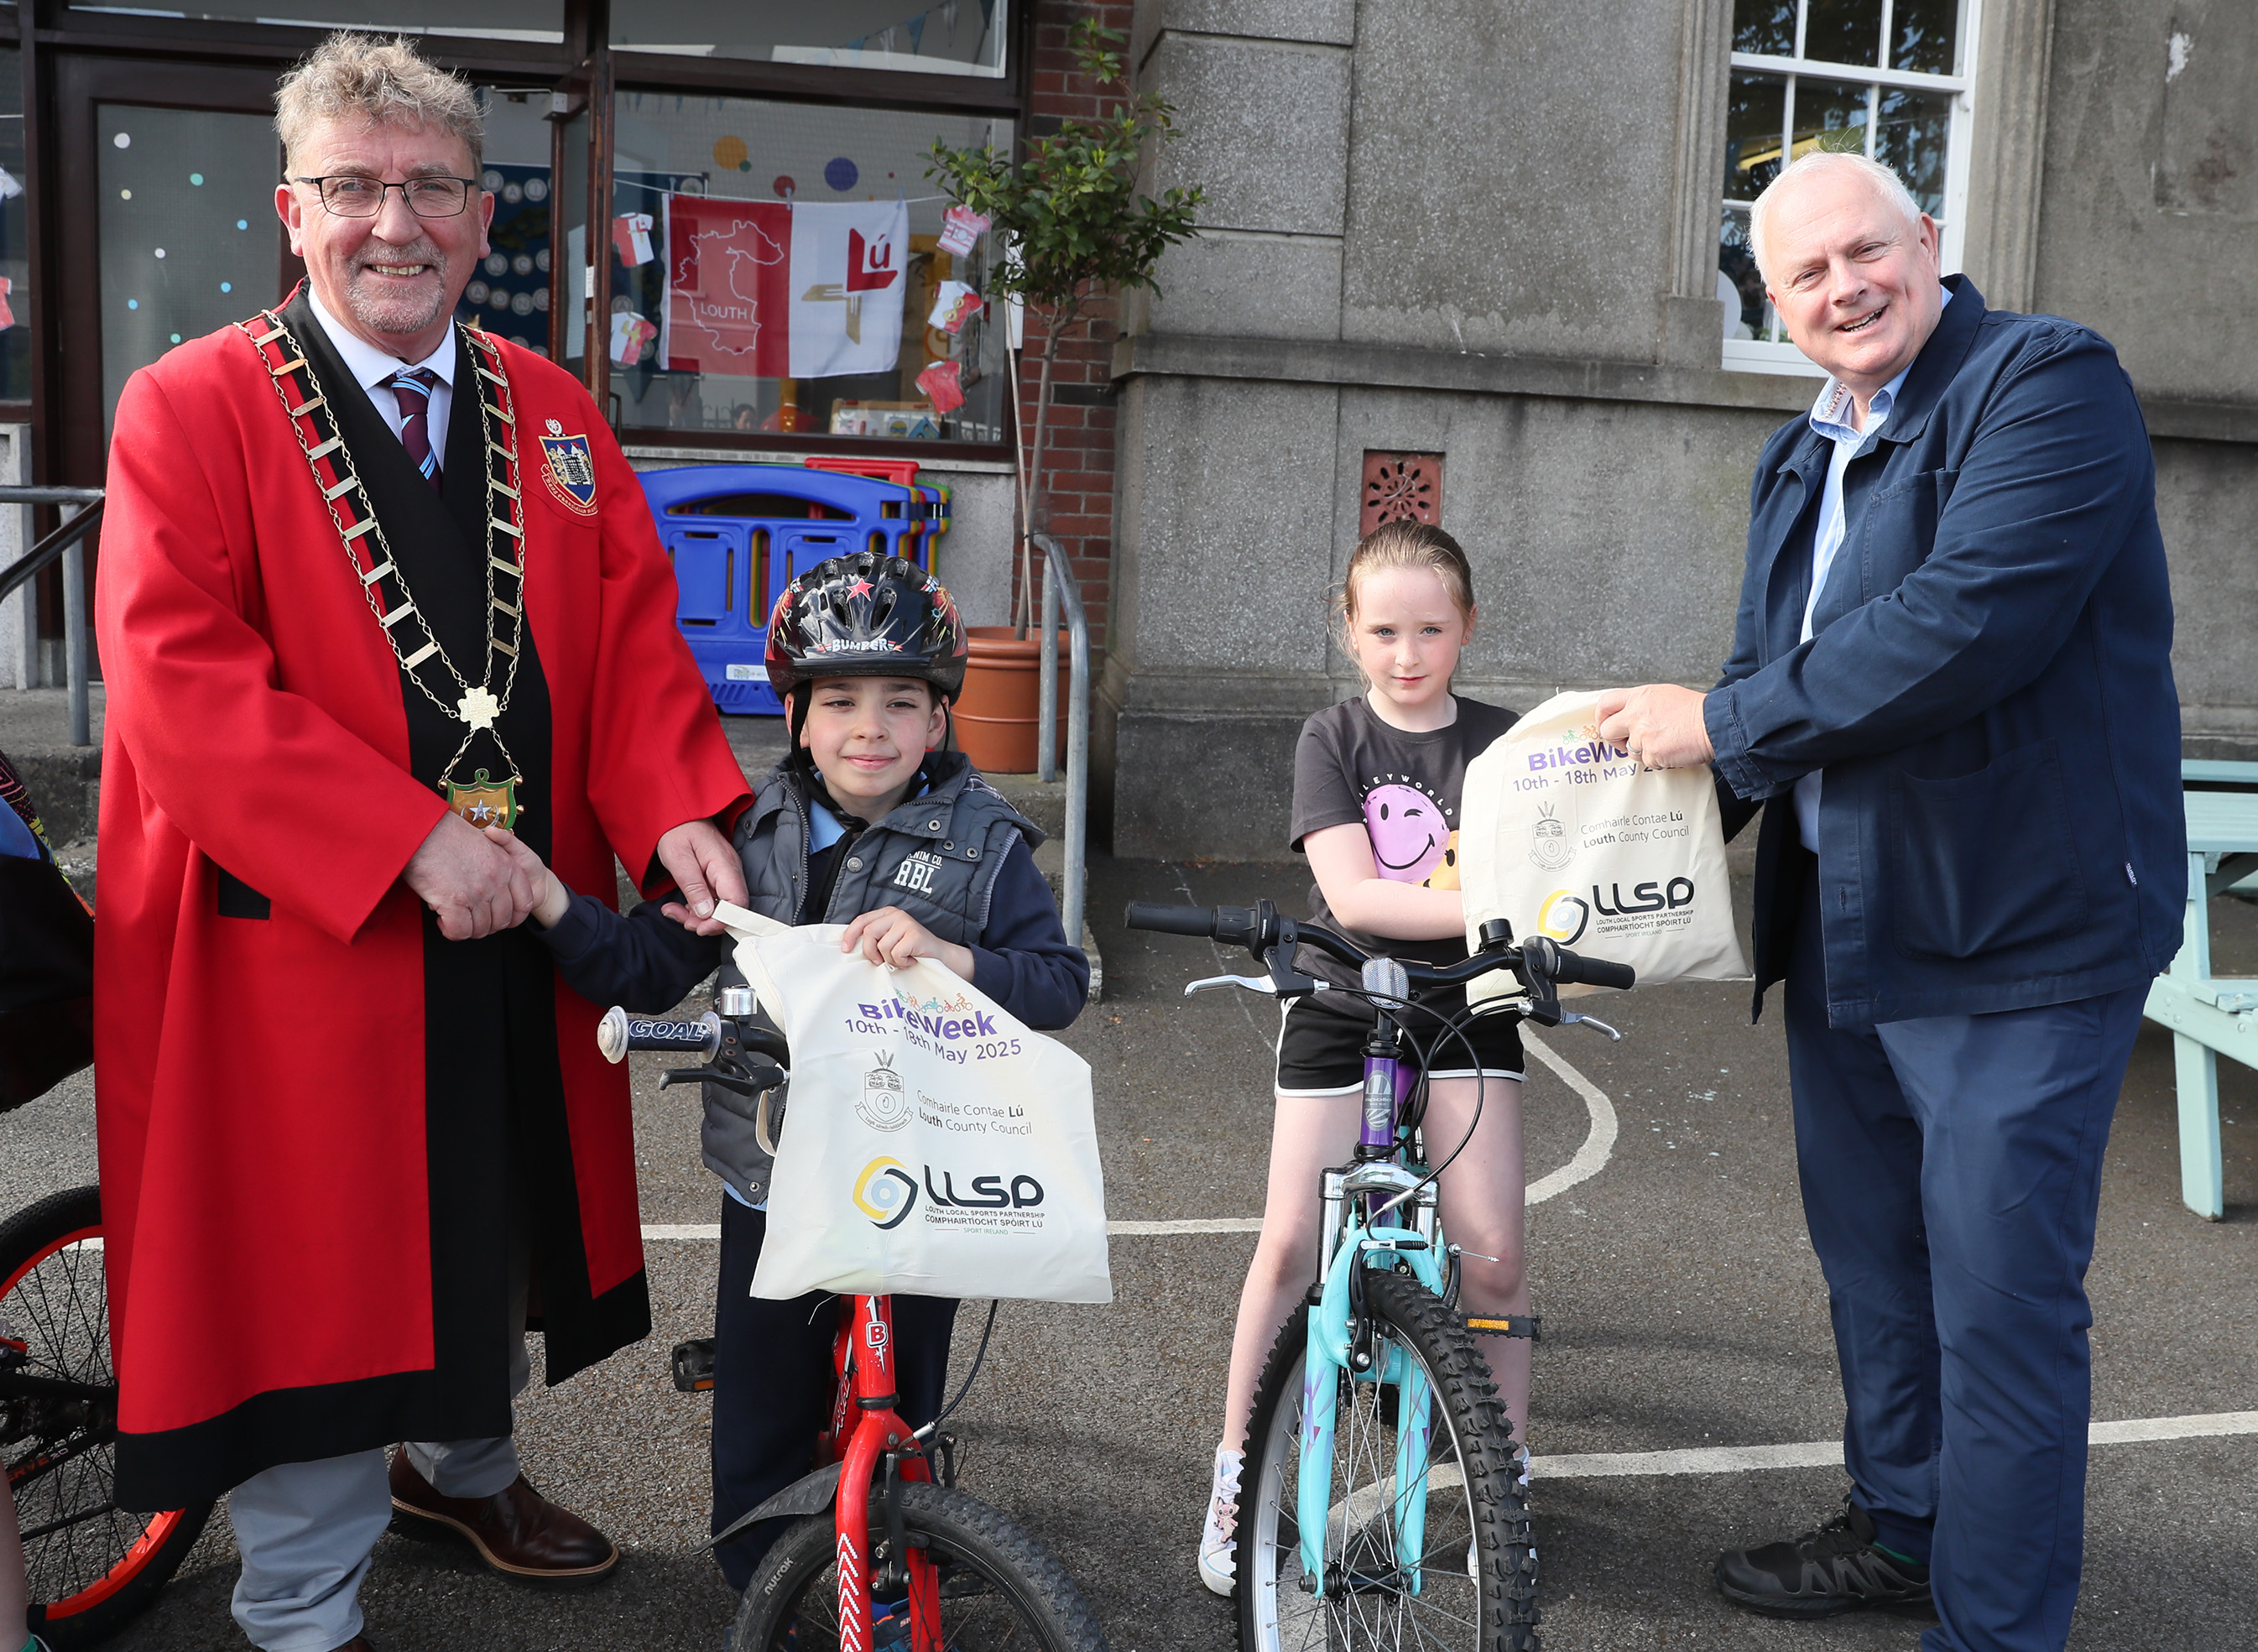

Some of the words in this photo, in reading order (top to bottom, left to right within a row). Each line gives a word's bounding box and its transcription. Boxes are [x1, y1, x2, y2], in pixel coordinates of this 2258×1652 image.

[847, 227, 898, 292] Lú
[700, 301, 748, 320] LOUTH
[832, 638, 889, 653] BUMPER
[1513, 775, 1549, 792] 10th
[1565, 769, 1598, 785] 18th
[1603, 763, 1637, 781] May
[1581, 815, 1630, 835] Comhairle
[1632, 814, 1667, 826] Contae
[1670, 810, 1683, 821] Lú
[1583, 833, 1616, 848] Louth
[1619, 831, 1649, 843] County
[1652, 826, 1689, 839] Council
[1631, 914, 1655, 922] SPORTS
[1656, 909, 1693, 919] PARTNERSHIP
[629, 1020, 704, 1041] GOAL
[857, 998, 997, 1040] BikeWeek
[845, 1019, 887, 1034] 10th
[903, 1026, 931, 1051] 18th
[935, 1041, 967, 1065] May
[975, 1039, 1022, 1060] 2025
[917, 1090, 960, 1115] Comhairle
[963, 1104, 1005, 1118] Contae
[1009, 1104, 1024, 1118] Lú
[919, 1107, 943, 1128] Louth
[946, 1119, 987, 1133] County
[990, 1121, 1032, 1135] Council
[925, 1205, 945, 1215] LOUTH
[1000, 1218, 1030, 1227] SPÓIRT
